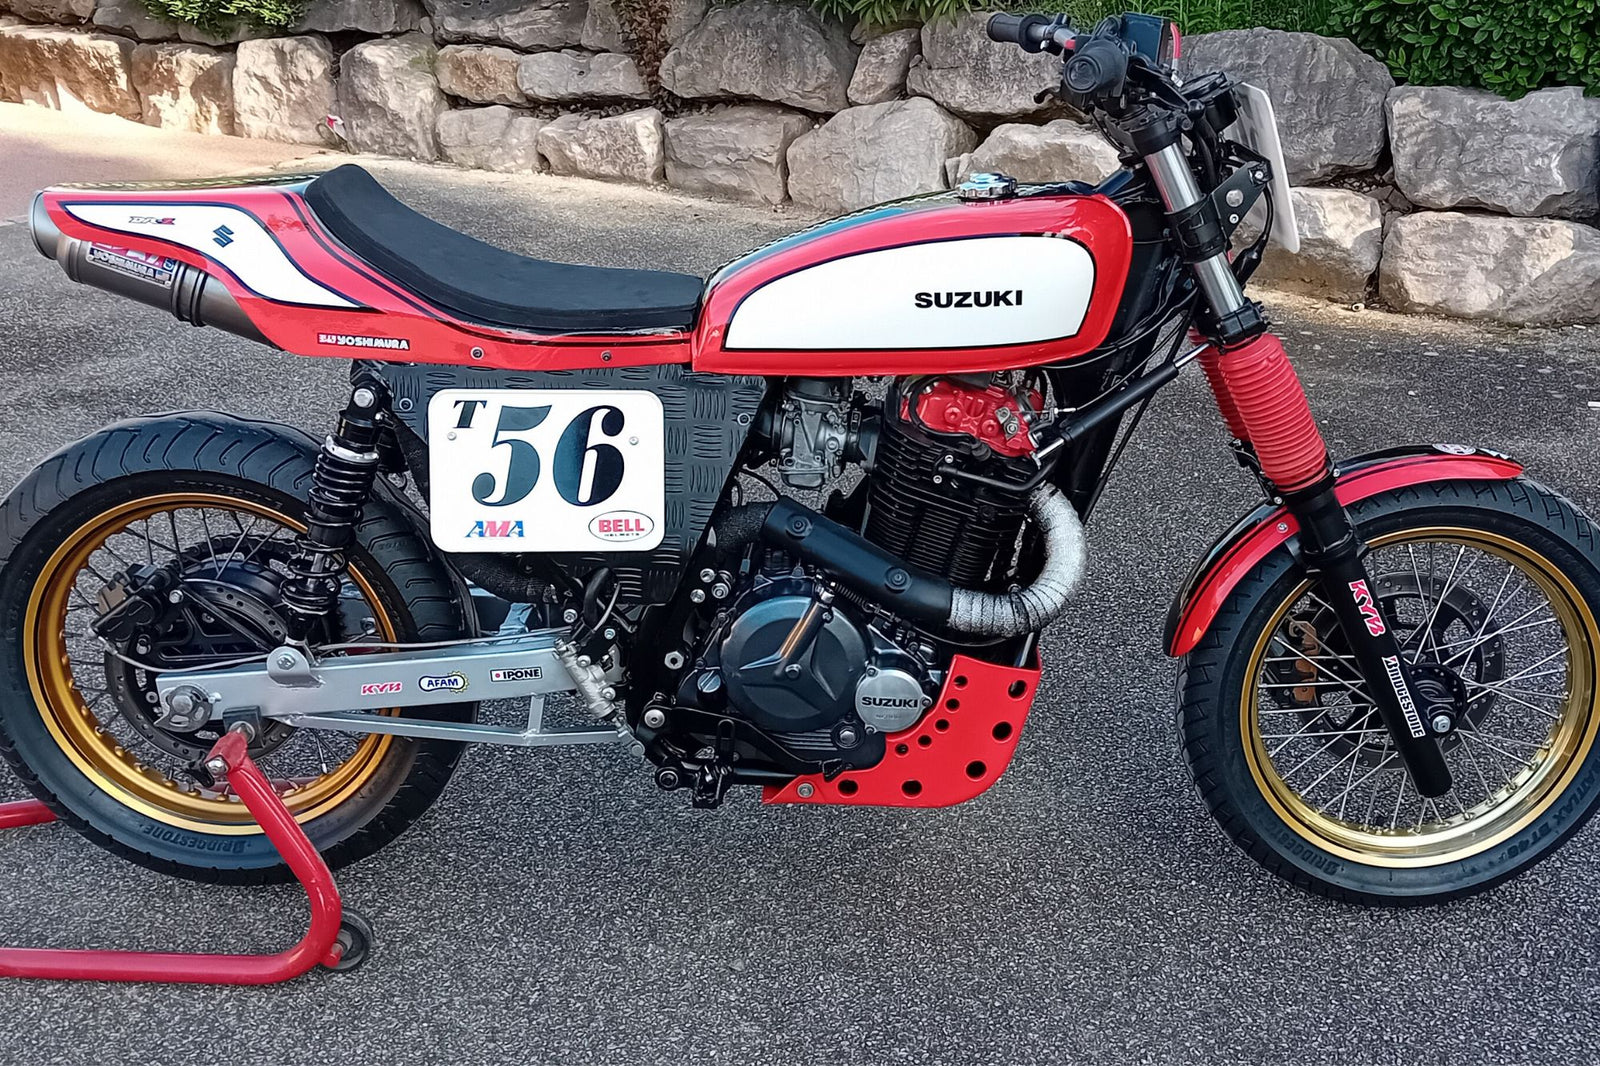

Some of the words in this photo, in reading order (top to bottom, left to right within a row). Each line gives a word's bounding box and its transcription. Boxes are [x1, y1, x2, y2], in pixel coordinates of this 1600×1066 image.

[914, 290, 1023, 309] SUZUKI
[337, 335, 409, 350] YOSHIMURA
[452, 400, 488, 429] T
[471, 404, 625, 507] 56
[464, 520, 525, 538] AMA
[598, 518, 646, 533] BELL
[1348, 578, 1386, 637] KYB
[503, 668, 541, 679] IPONE
[427, 678, 459, 688] AFAM
[861, 696, 919, 708] SUZUKI
[1382, 654, 1426, 738] BRIDGESTONE
